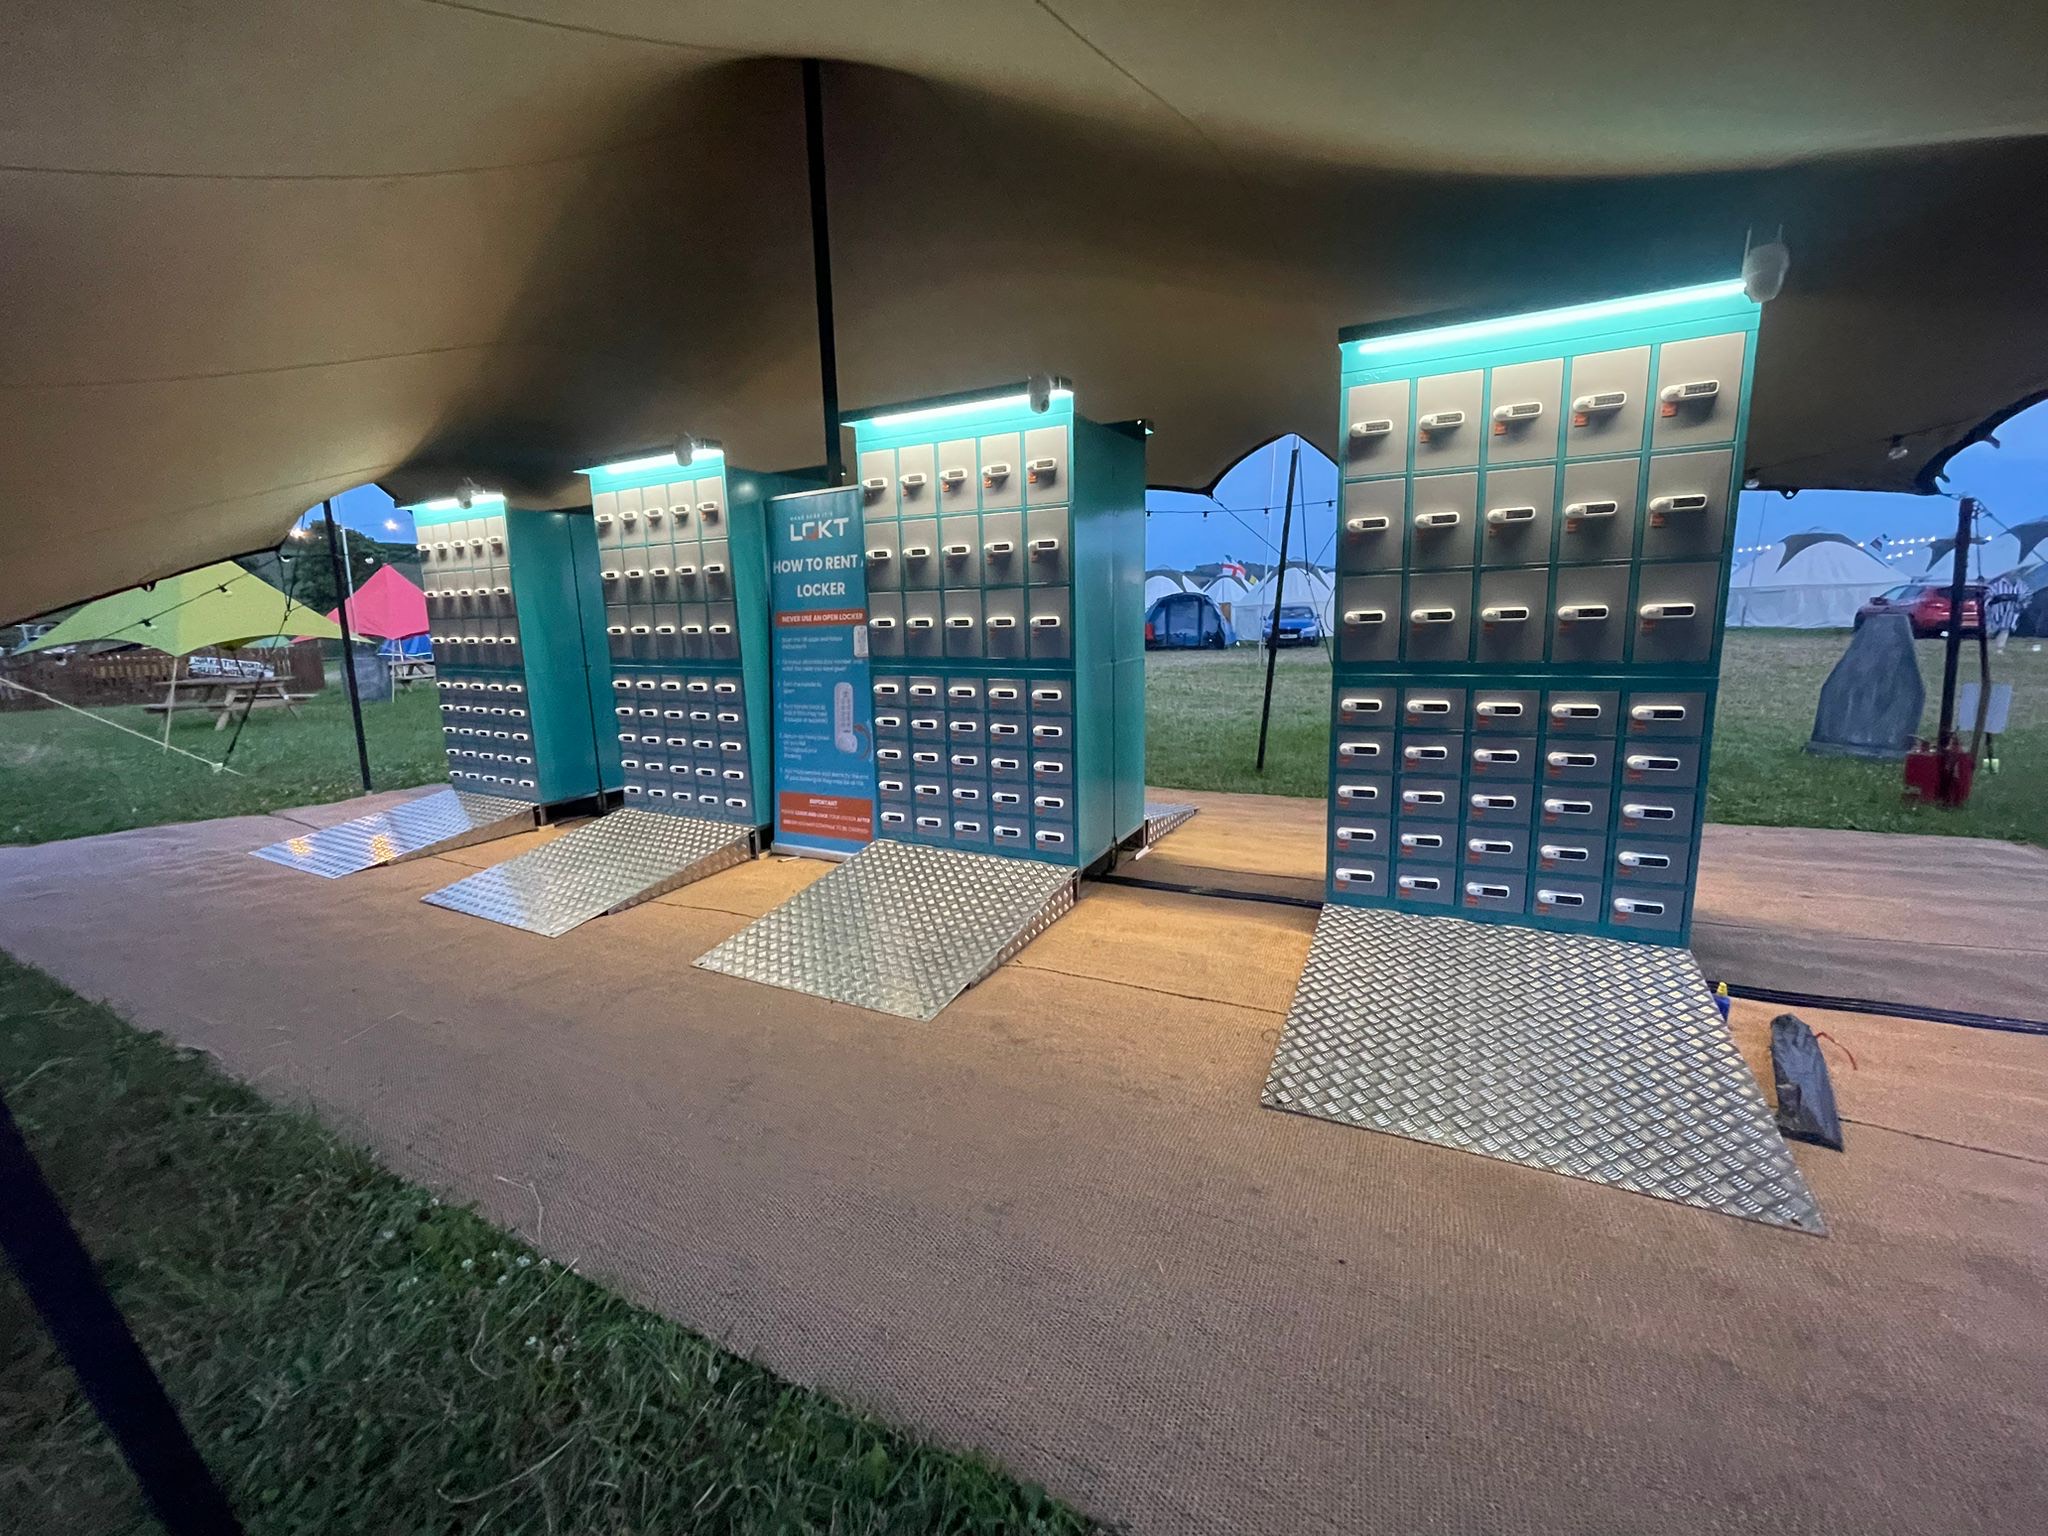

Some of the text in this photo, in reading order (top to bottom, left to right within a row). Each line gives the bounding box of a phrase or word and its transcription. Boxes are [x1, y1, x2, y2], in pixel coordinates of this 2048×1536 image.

[773, 559, 803, 574] HOW
[806, 557, 823, 571] TO
[825, 554, 858, 570] RENT
[797, 582, 845, 597] LOCKER
[782, 615, 800, 623] NEVER
[823, 613, 839, 621] OPEN
[839, 612, 863, 620] LOCKER
